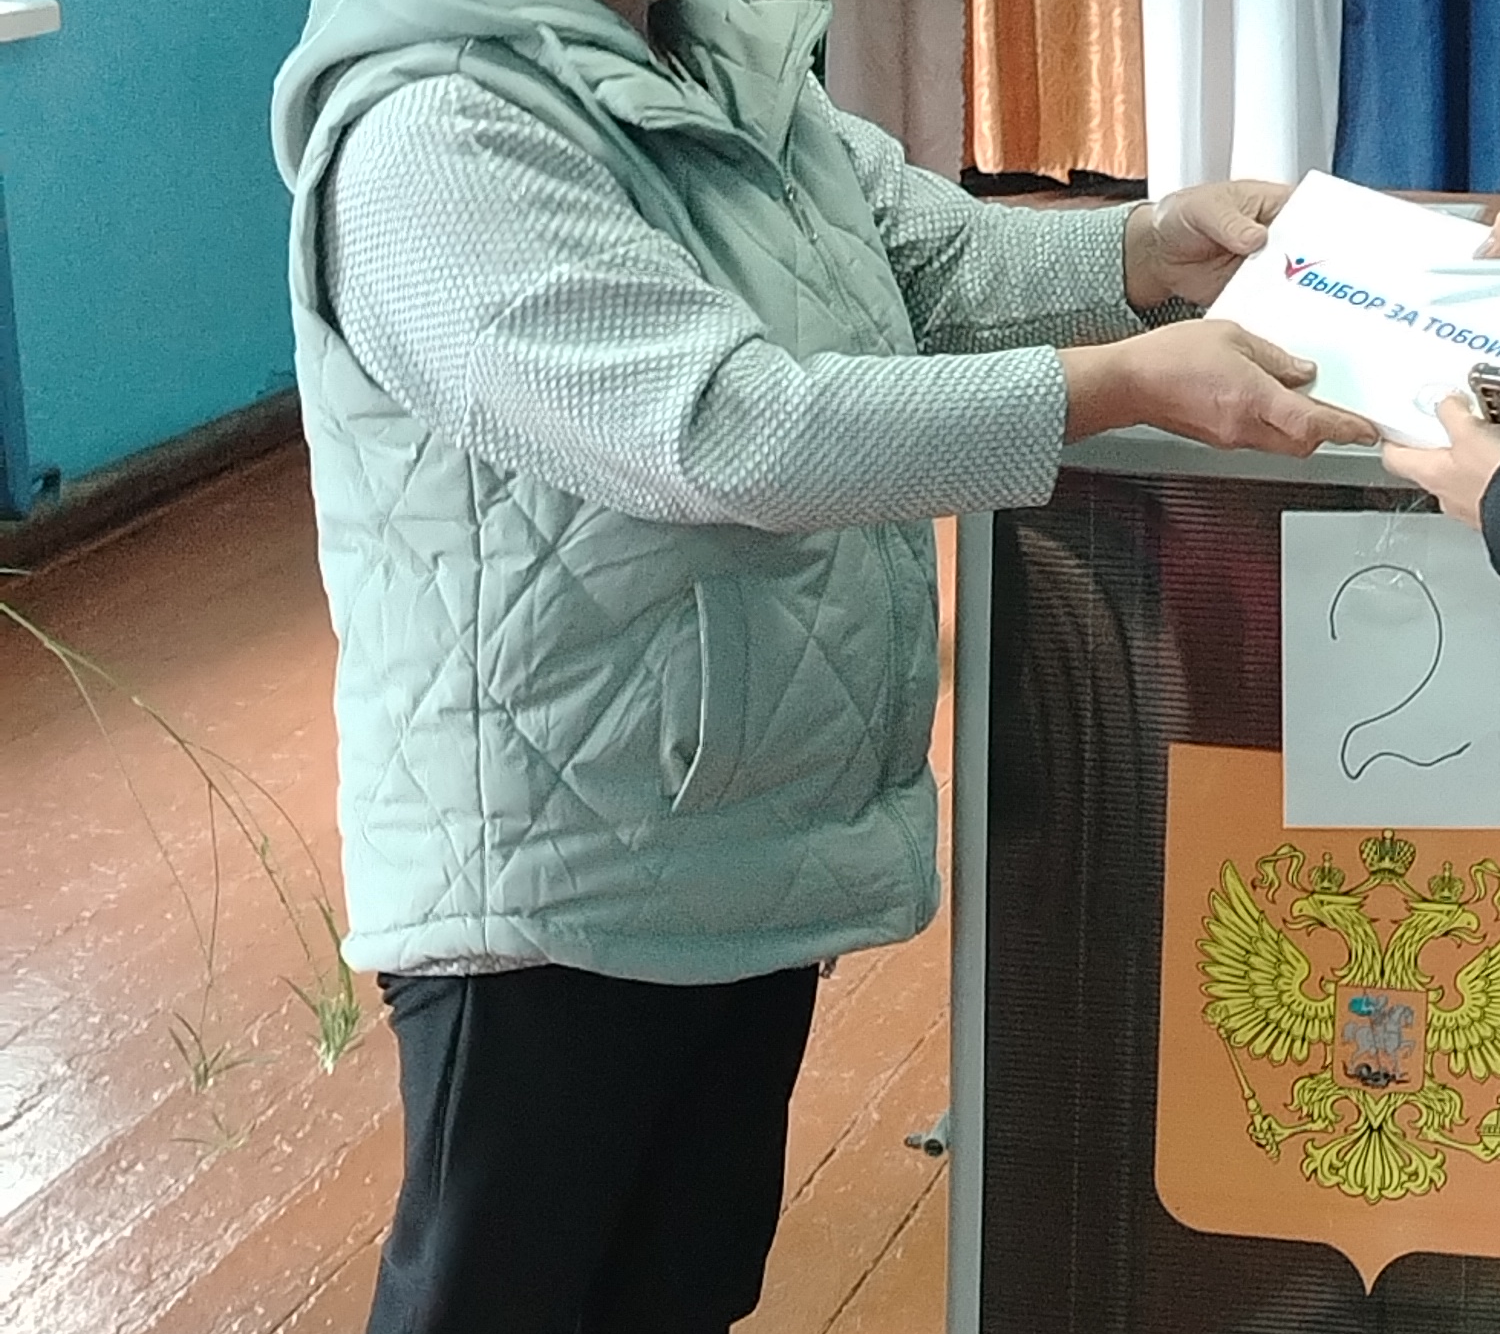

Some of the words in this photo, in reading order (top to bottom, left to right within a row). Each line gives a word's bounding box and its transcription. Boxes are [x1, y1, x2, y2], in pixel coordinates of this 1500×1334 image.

[1297, 270, 1386, 310] ВЫБОР
[1384, 303, 1419, 328] ЗА
[1329, 563, 1472, 780] 2
